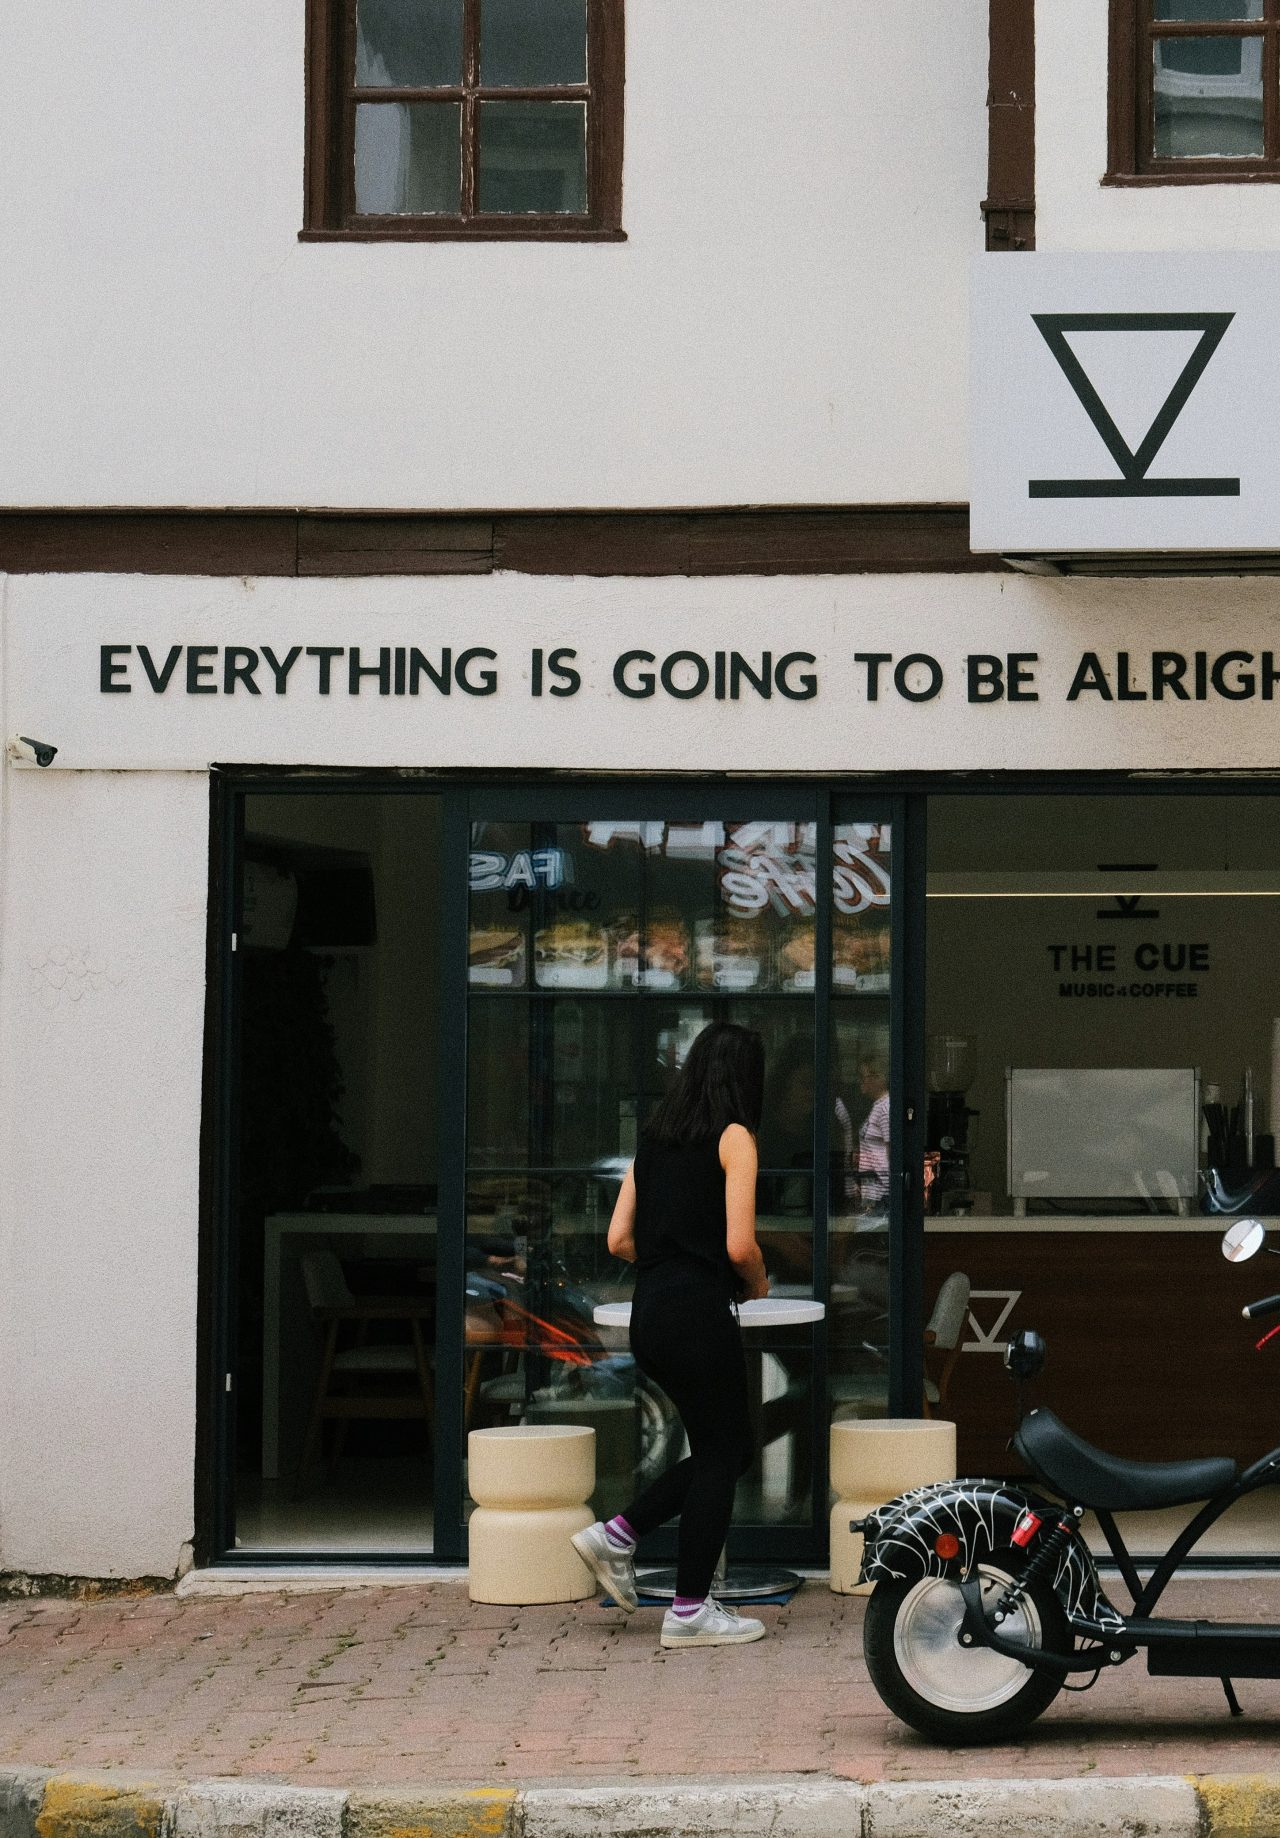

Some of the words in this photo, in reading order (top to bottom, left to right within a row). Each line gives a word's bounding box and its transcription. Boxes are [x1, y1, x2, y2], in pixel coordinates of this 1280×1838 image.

[101, 645, 497, 696] EVERYTHING
[532, 649, 581, 697] IS
[614, 650, 817, 700] GOING
[855, 653, 943, 702] TO
[967, 653, 1039, 703] BE
[1047, 944, 1117, 972] THE
[1134, 943, 1210, 973] CUE
[1059, 983, 1115, 998] MUSIC
[1130, 983, 1198, 999] COFFEE
